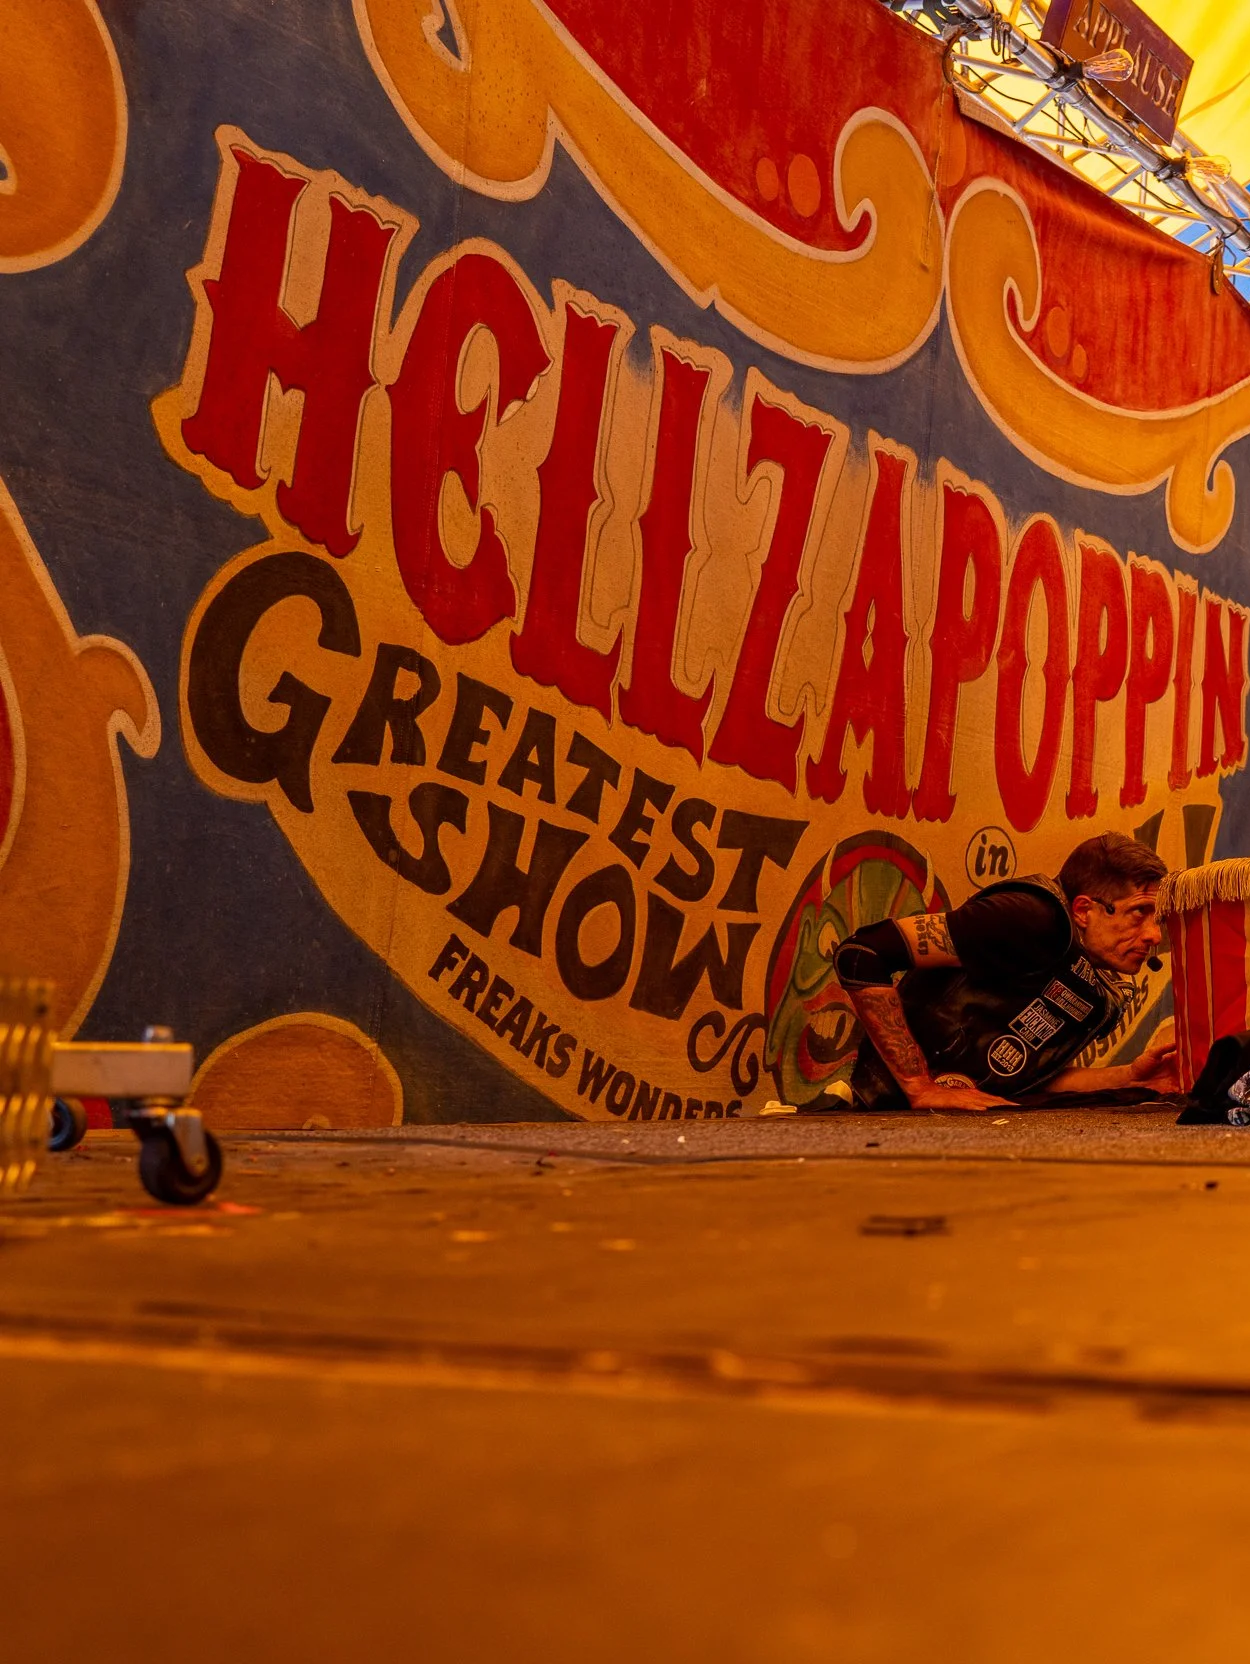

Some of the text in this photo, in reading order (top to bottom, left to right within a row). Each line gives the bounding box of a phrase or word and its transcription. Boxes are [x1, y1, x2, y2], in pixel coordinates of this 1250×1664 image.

[181, 144, 1250, 832] HELLZAPOPPIN
[188, 551, 809, 913] GREATEST
[347, 782, 762, 1021] SHOW
[974, 833, 1011, 878] in
[428, 933, 577, 1078] FREAKS
[996, 1039, 1023, 1067] HHH
[1020, 1010, 1055, 1040] FUCKING
[1034, 1004, 1059, 1028] JASMINE
